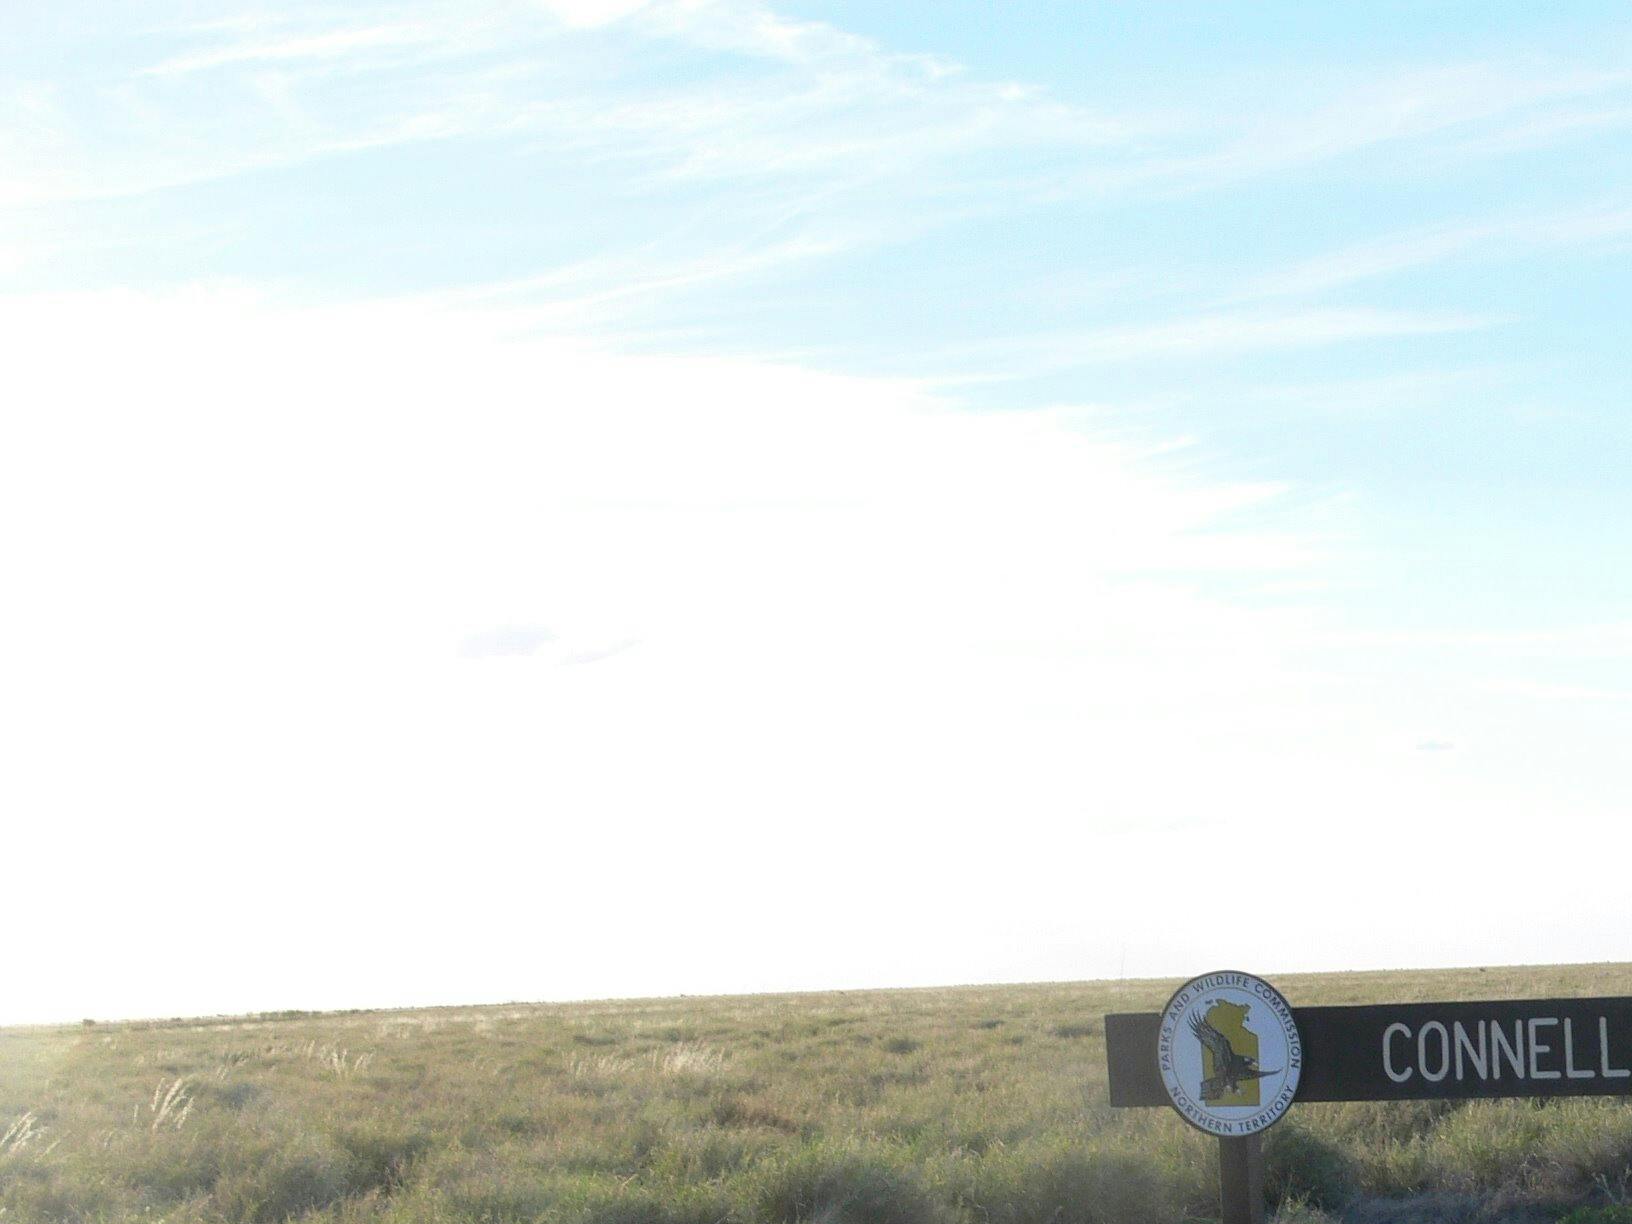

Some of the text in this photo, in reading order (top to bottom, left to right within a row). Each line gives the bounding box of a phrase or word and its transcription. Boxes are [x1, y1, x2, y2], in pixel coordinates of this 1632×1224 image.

[1161, 976, 1302, 1071] PARKS AND WILDLIFE COMMISSION
[1171, 1084, 1295, 1133] NORTHERN TERRITORY
